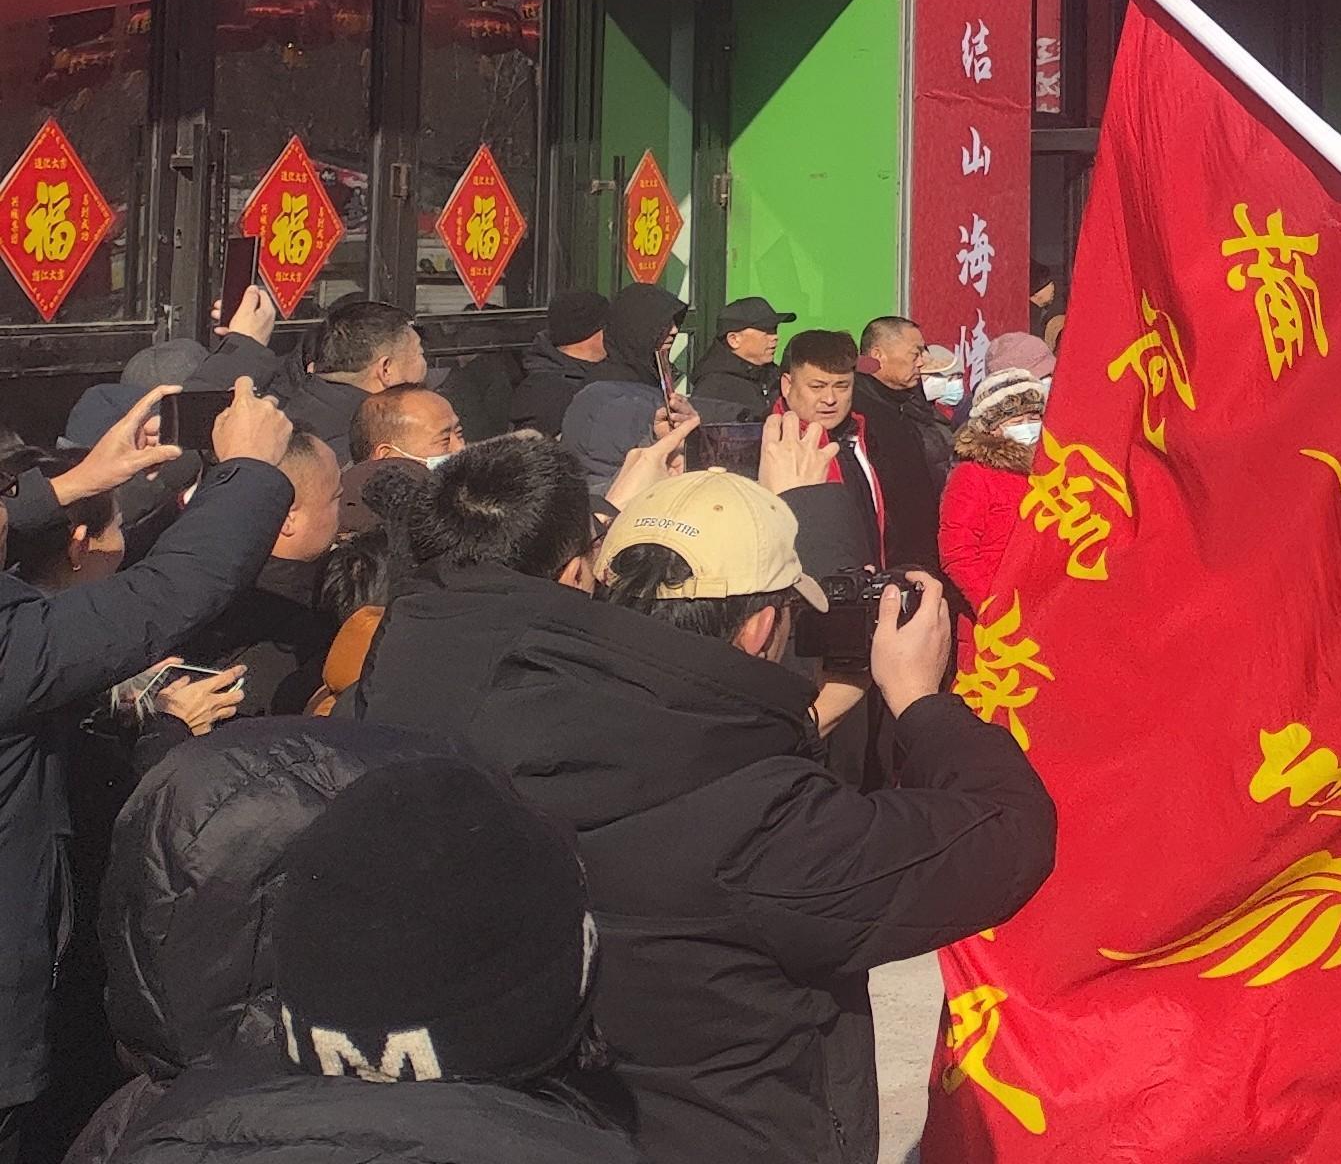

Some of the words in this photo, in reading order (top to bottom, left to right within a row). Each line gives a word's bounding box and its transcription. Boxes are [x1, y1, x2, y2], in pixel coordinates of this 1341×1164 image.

[23, 181, 77, 262] 福
[269, 192, 313, 265] 福
[465, 195, 500, 261] 福
[633, 196, 663, 256] 福
[634, 517, 657, 528] LIFE
[658, 518, 673, 529] OF
[675, 522, 700, 537] THE
